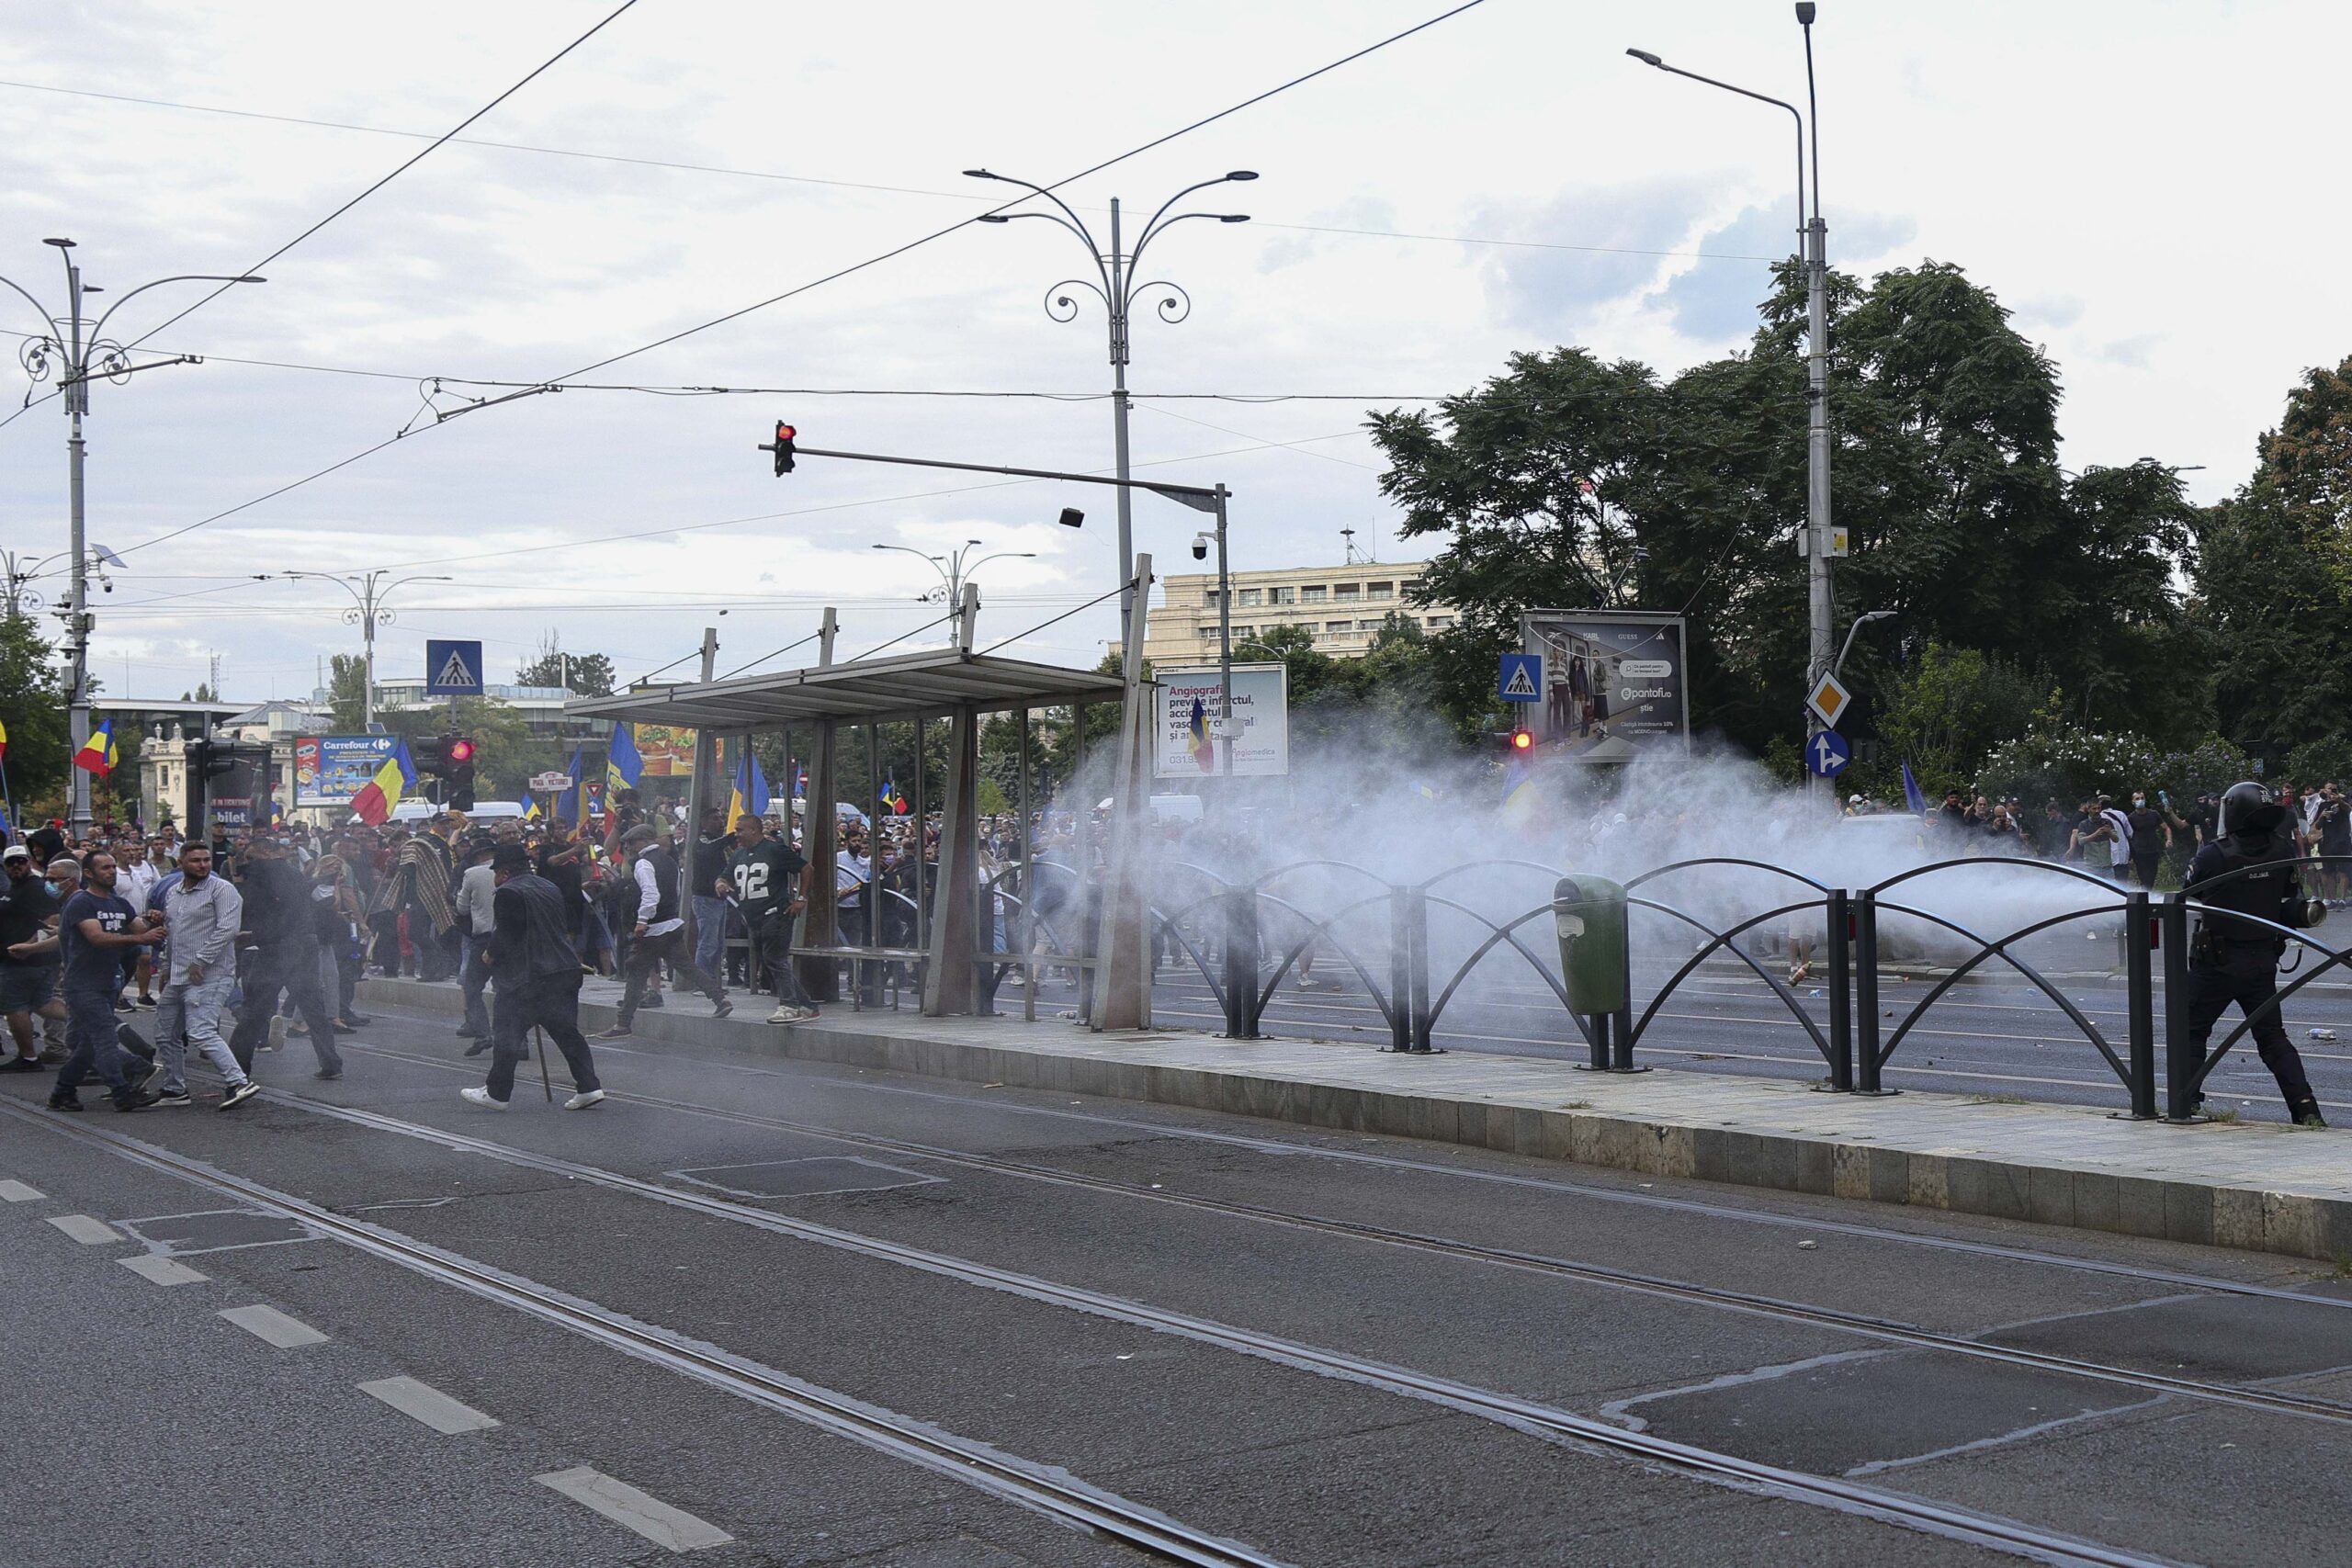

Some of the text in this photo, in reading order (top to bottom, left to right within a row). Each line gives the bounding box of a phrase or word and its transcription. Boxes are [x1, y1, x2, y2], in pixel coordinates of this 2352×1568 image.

[1169, 684, 1223, 698] Angiografi
[1170, 694, 1254, 709] previe infrctul,
[323, 740, 369, 750] Carrefour
[734, 863, 769, 901] 92
